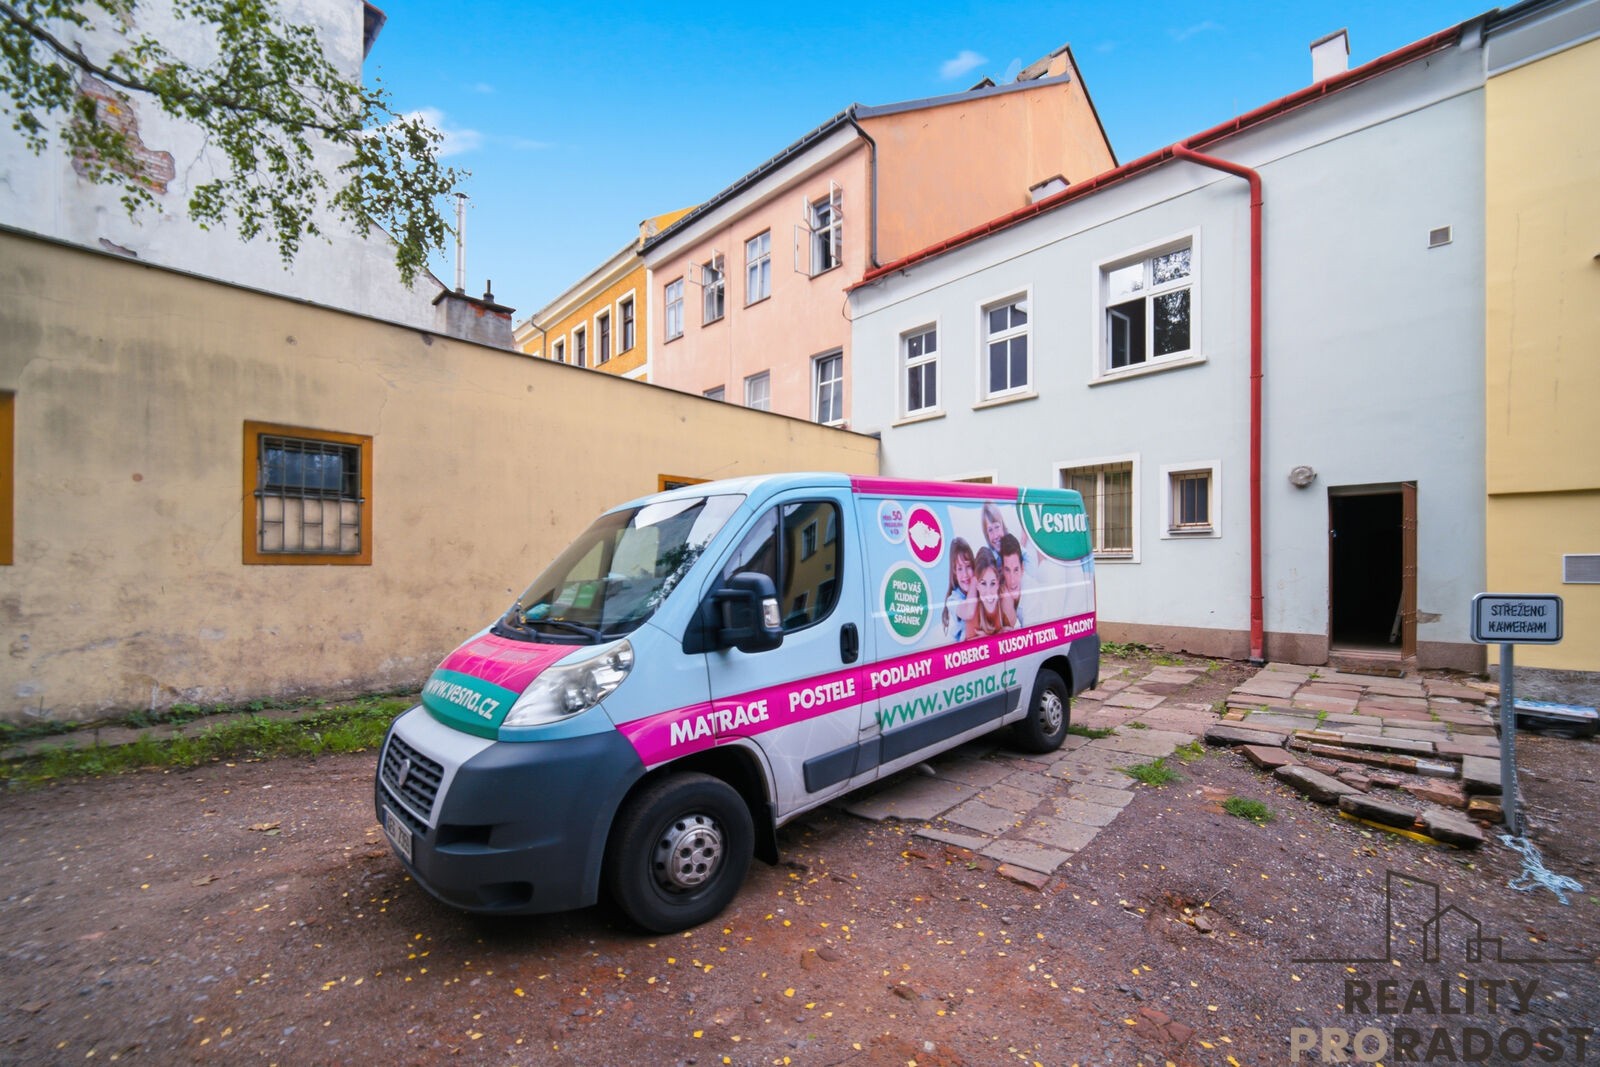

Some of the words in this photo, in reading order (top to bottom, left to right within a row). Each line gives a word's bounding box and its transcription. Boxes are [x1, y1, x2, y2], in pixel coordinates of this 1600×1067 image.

[1028, 504, 1087, 533] Vesna
[892, 580, 908, 591] PRO
[908, 581, 922, 593] VÁŠ
[894, 591, 920, 604] KLIDNÝ
[889, 602, 896, 612] A
[896, 603, 924, 615] ZDRAVÝ
[1491, 602, 1547, 617] STŘEŽENO
[893, 613, 921, 626] SPÁNEK
[1488, 620, 1547, 633] KAMERAMI
[670, 700, 769, 746] MATRACE
[788, 678, 856, 713] POSTELE
[870, 658, 932, 691] PODLAHY
[944, 644, 990, 670] KOBERCE
[998, 630, 1035, 655] KUSOVÝ
[1034, 628, 1059, 645] TEXTIL
[1063, 617, 1095, 638] ZÁCLONY
[426, 679, 500, 720] www.vesna.cz
[875, 668, 1017, 730] www.vesna.cz
